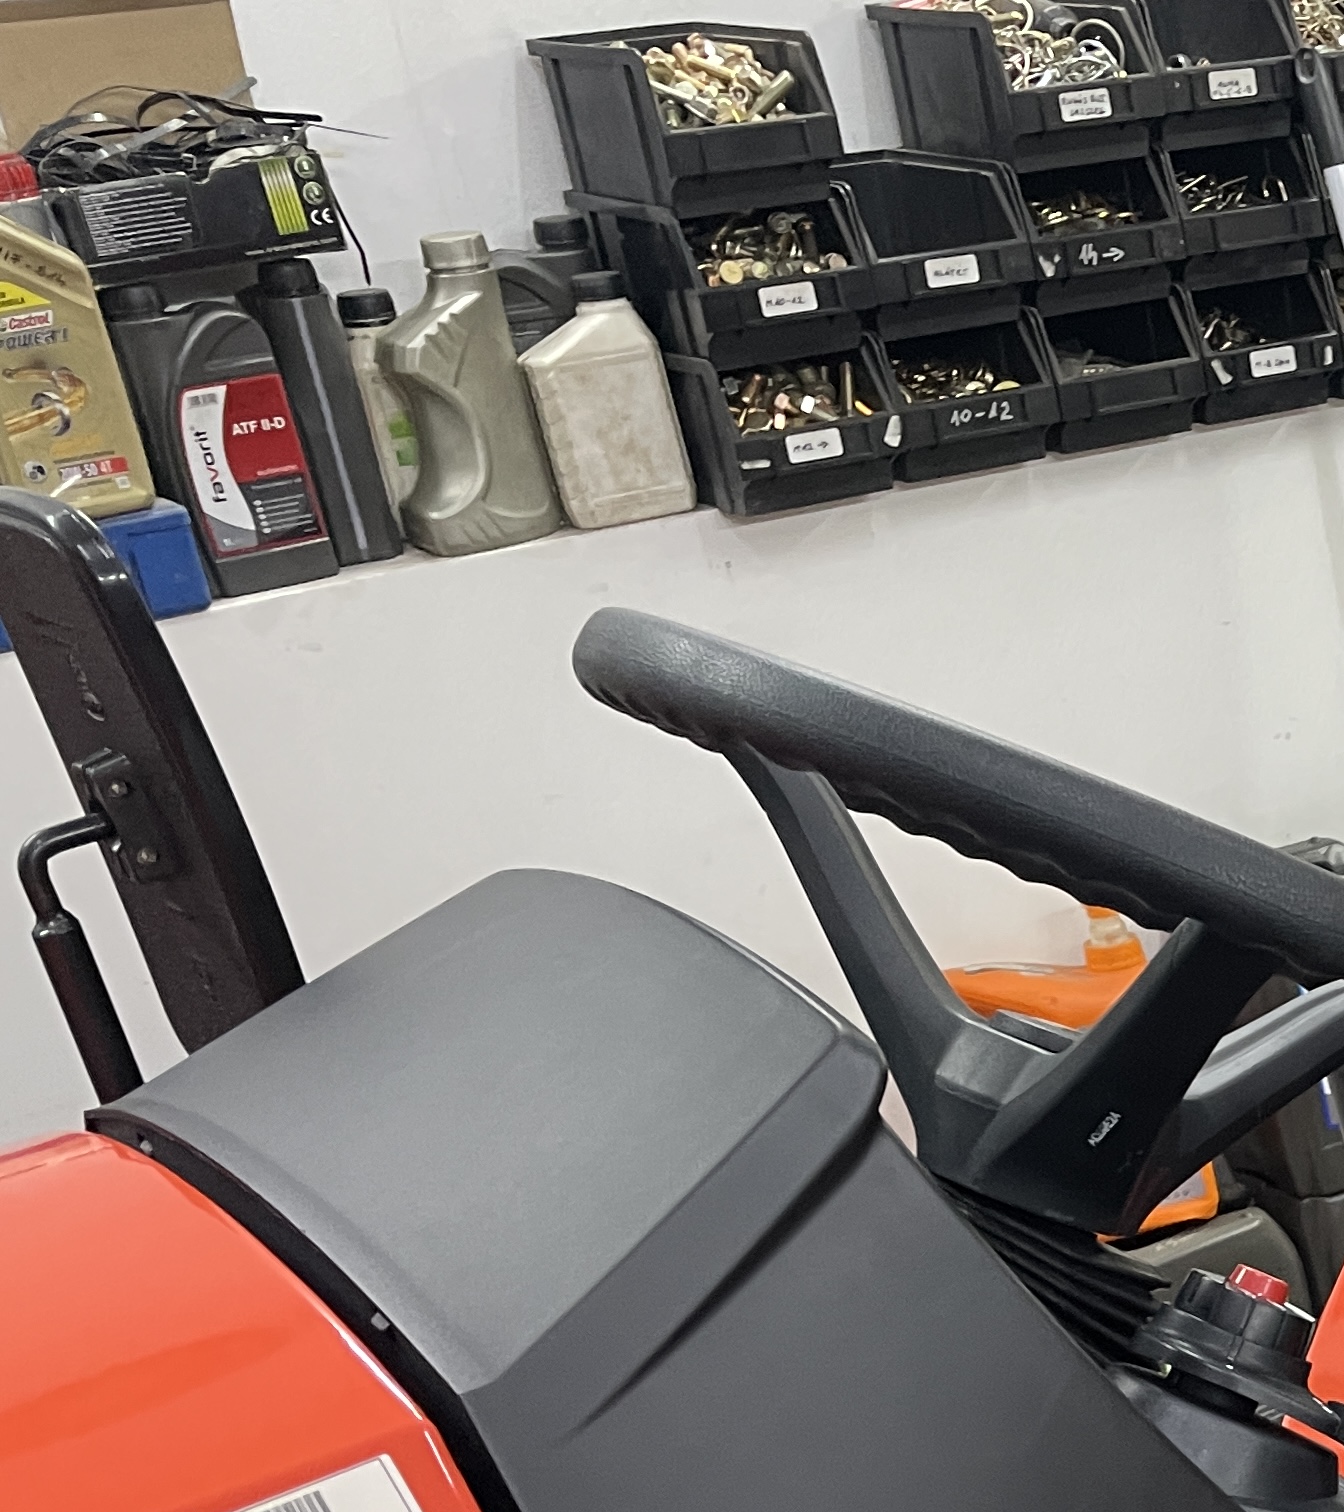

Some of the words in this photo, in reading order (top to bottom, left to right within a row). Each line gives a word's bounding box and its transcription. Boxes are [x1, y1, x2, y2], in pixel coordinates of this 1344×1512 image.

[232, 420, 259, 436] ATF
[950, 401, 1014, 428] 10-12
[193, 430, 228, 503] favorit
